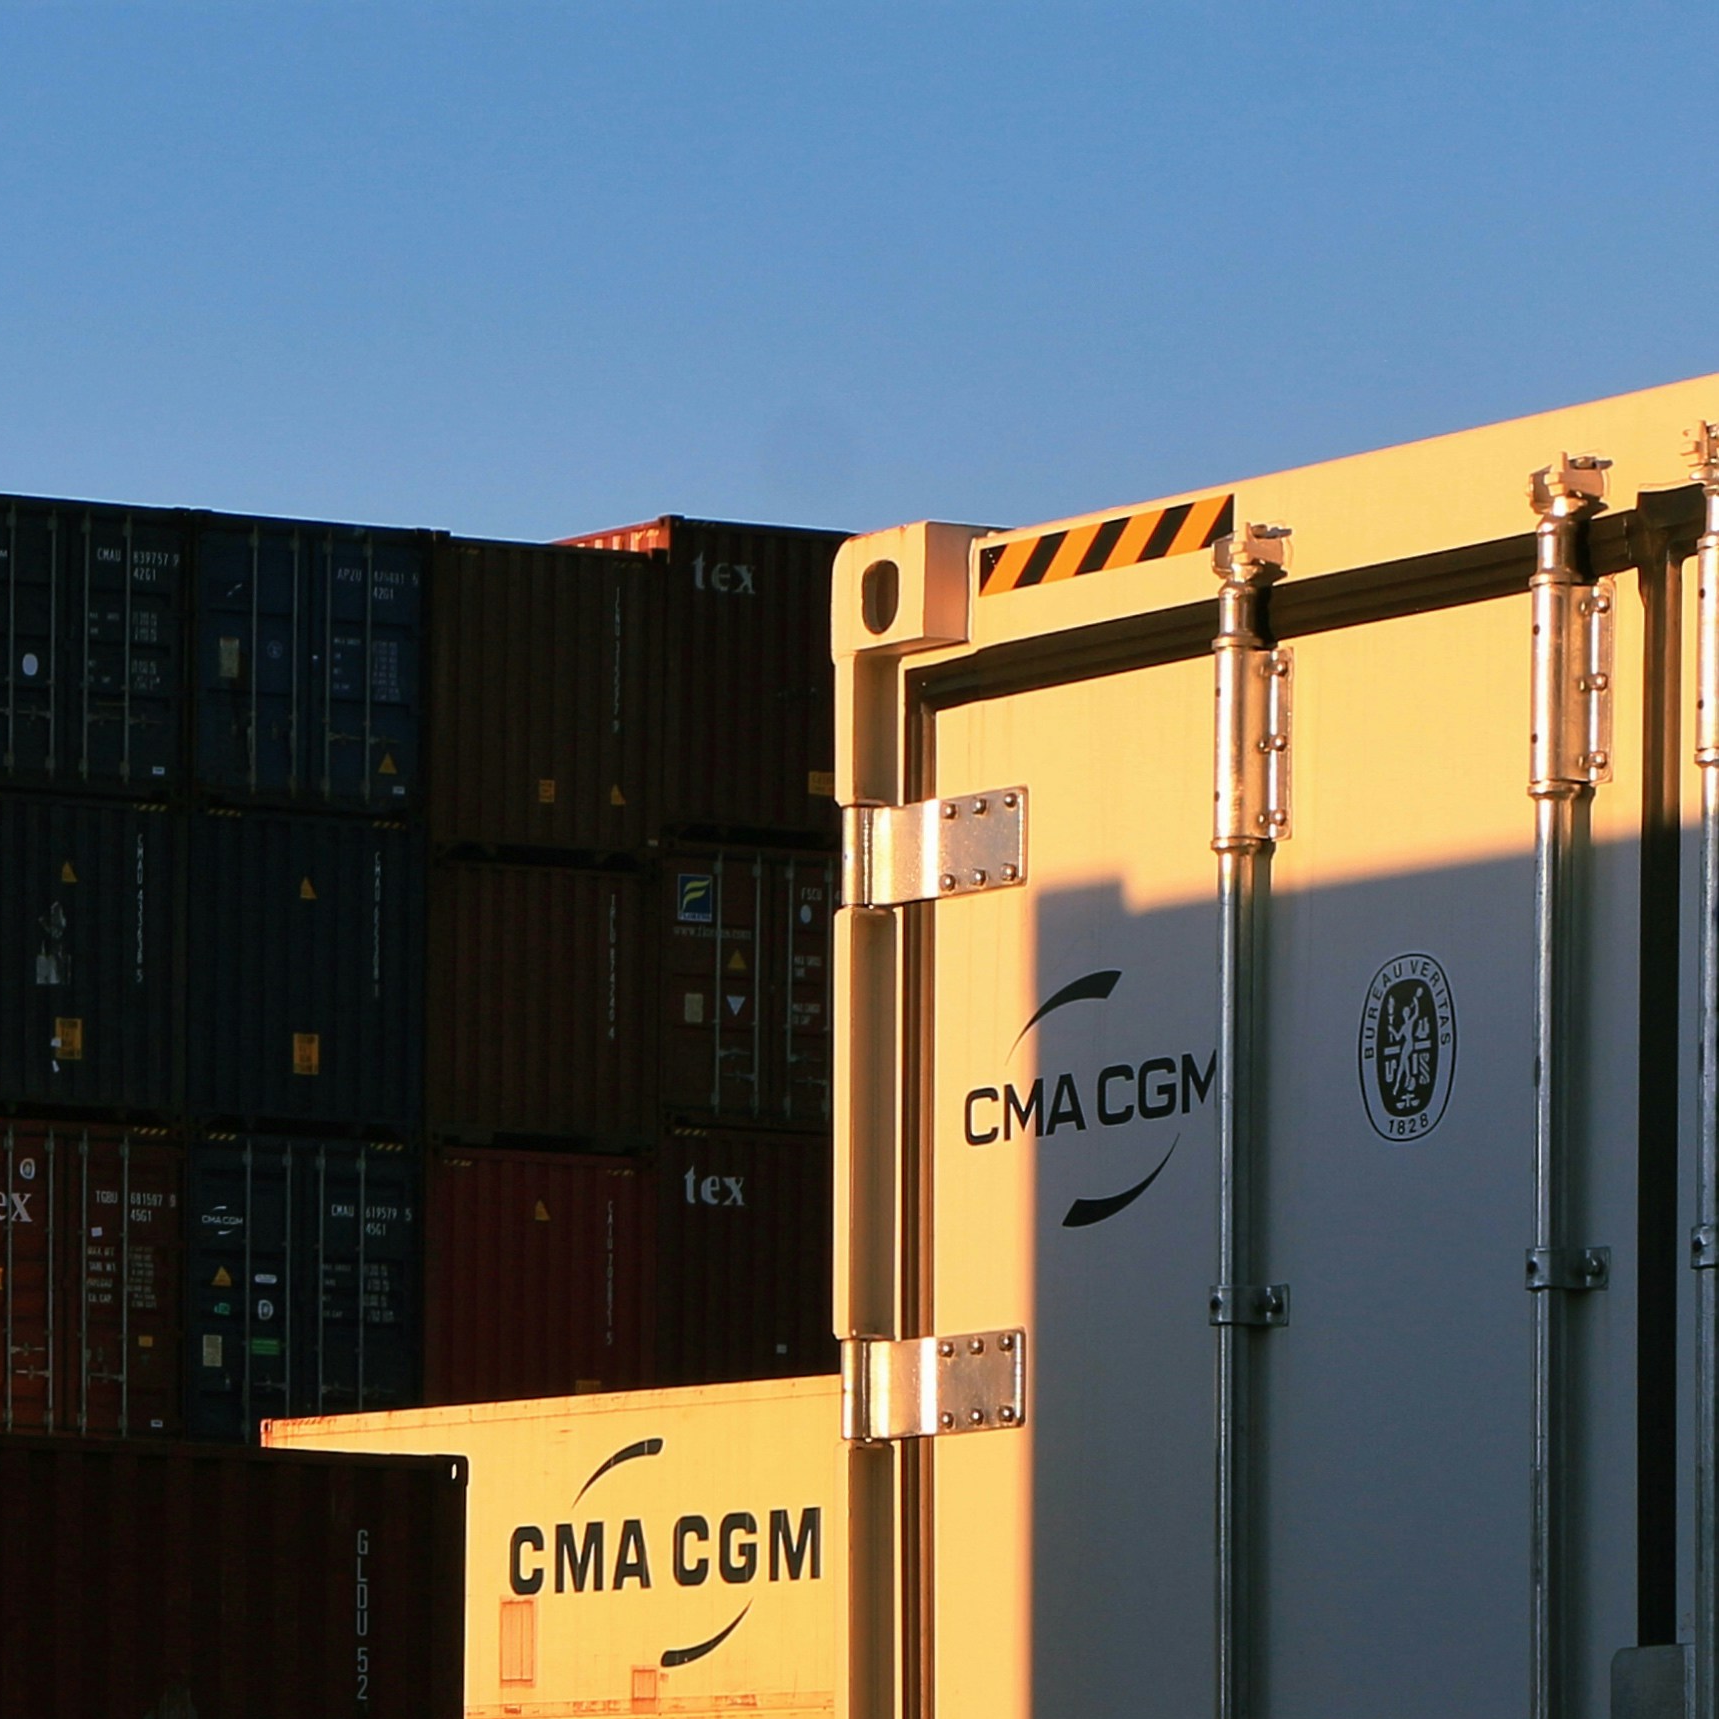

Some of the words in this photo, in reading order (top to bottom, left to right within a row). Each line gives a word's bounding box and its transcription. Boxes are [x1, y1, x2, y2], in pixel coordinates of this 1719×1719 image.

[97, 547, 122, 562] CMAU
[133, 567, 157, 581] 42G1
[337, 568, 362, 583] APZU
[691, 551, 756, 595] tex
[373, 587, 395, 600] 42G1
[136, 833, 145, 885] CMAU
[1364, 962, 1402, 1060] BUREAU
[1410, 959, 1451, 1046] VERITAS
[964, 1073, 1087, 1147] CMA
[1096, 1047, 1219, 1127] CGM
[1388, 1113, 1429, 1136] 1828
[684, 1164, 746, 1207] tex
[95, 1190, 118, 1204] TGBU
[130, 1209, 152, 1223] 45G1
[201, 1214, 223, 1225] CMA
[331, 1204, 355, 1218] CMAU
[365, 1206, 398, 1220] 619579
[405, 1207, 412, 1222] 5
[364, 1223, 387, 1236] 45G1
[509, 1519, 652, 1596] CMA
[672, 1507, 822, 1588] CGM
[356, 1529, 369, 1636] GLDU
